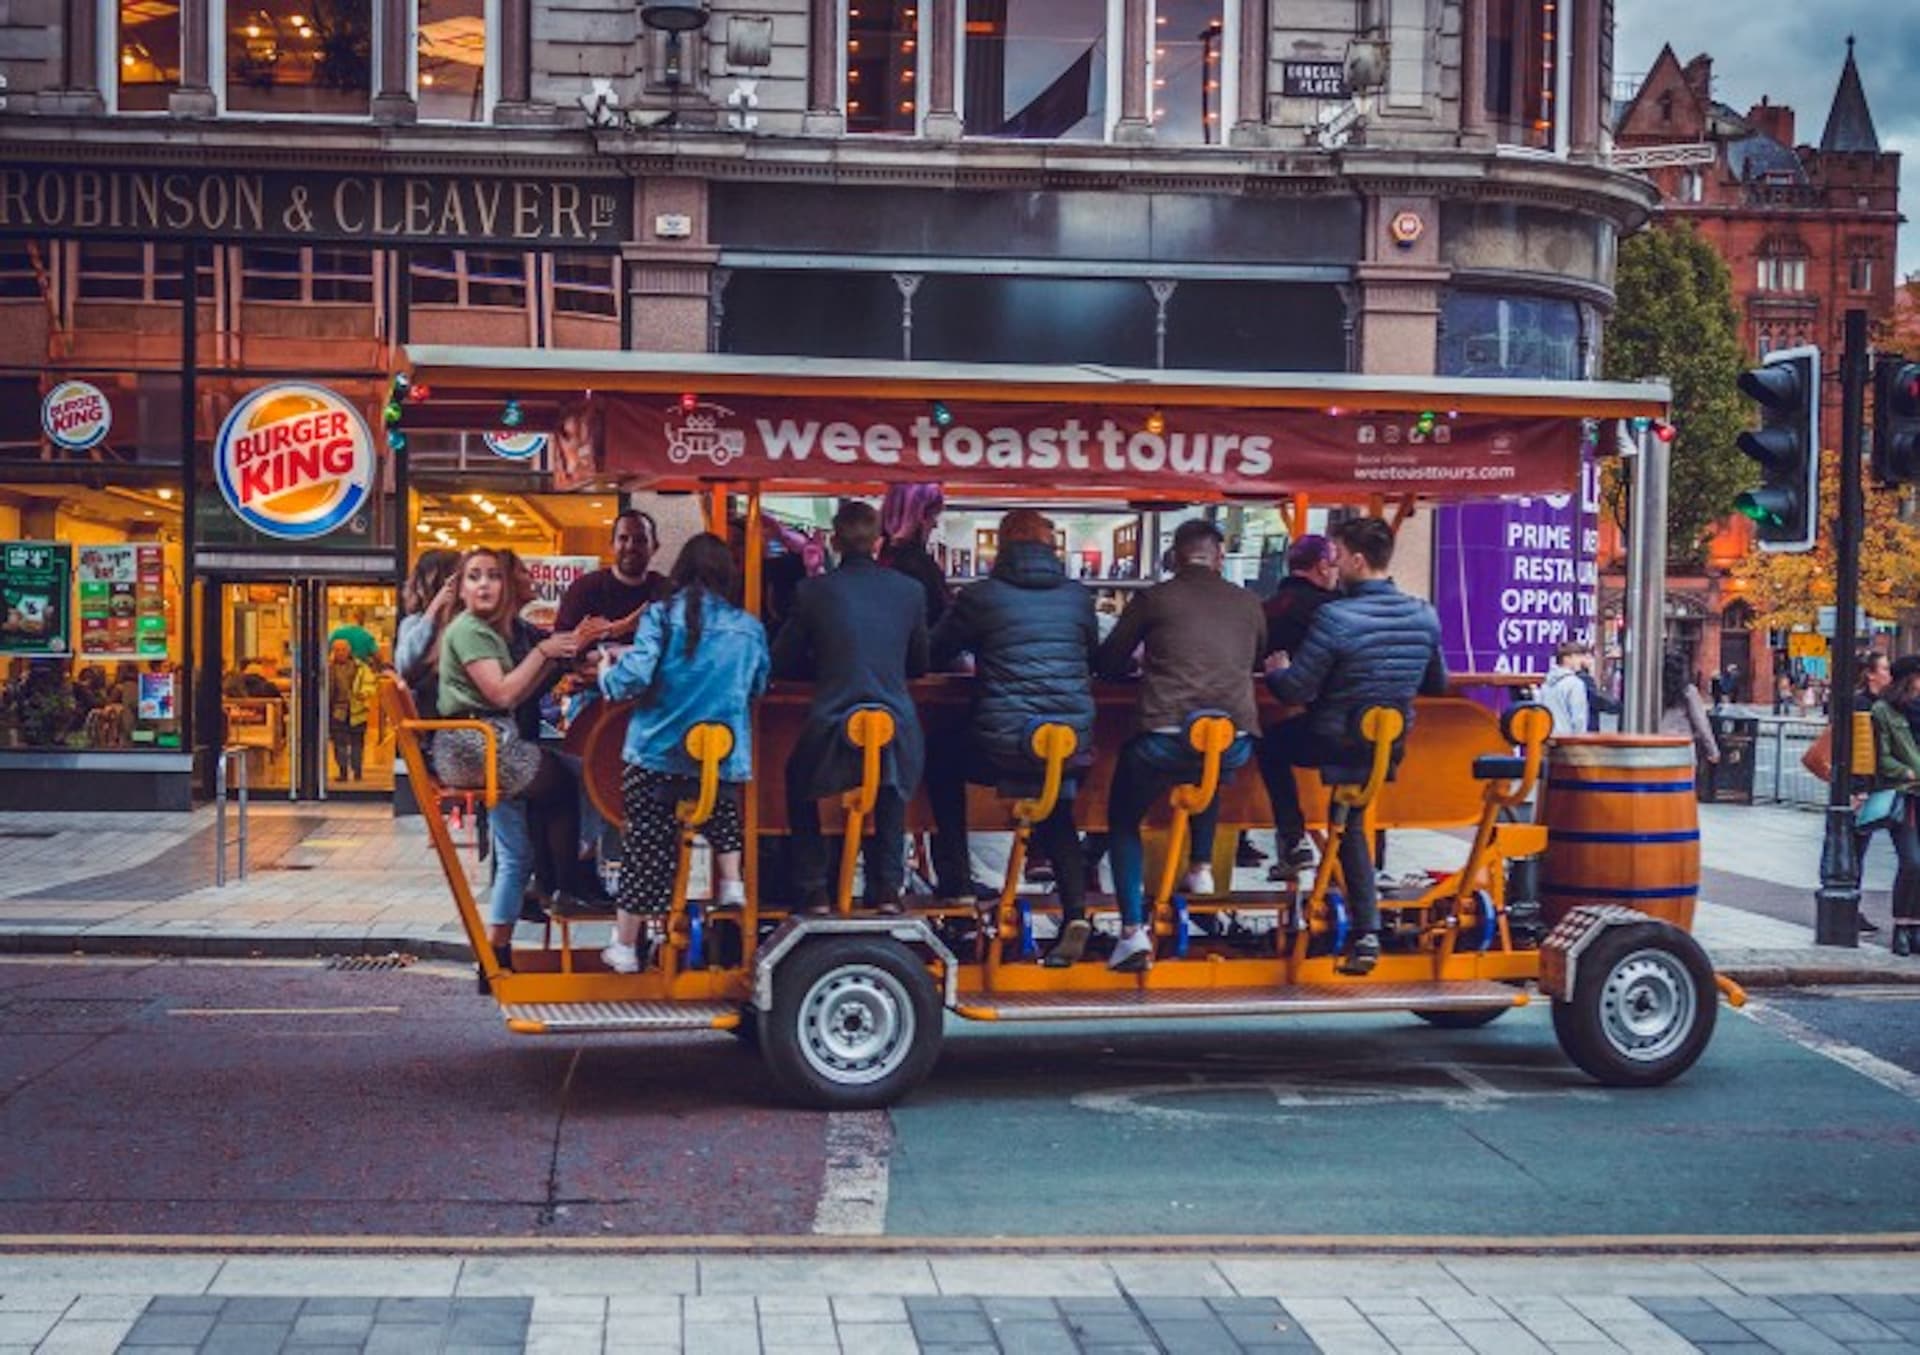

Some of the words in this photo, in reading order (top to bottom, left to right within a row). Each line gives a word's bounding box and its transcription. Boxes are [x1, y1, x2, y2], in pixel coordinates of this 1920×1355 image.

[0, 169, 264, 230] ROBINSON
[282, 185, 315, 232] &
[53, 407, 103, 432] KING
[235, 412, 349, 466] BURGER
[756, 418, 902, 463] wee
[911, 416, 1088, 469] toast
[1097, 418, 1272, 475] tours
[242, 439, 353, 503] KING
[1354, 466, 1515, 480] weetoasttours.com
[1507, 523, 1571, 549] PRIME
